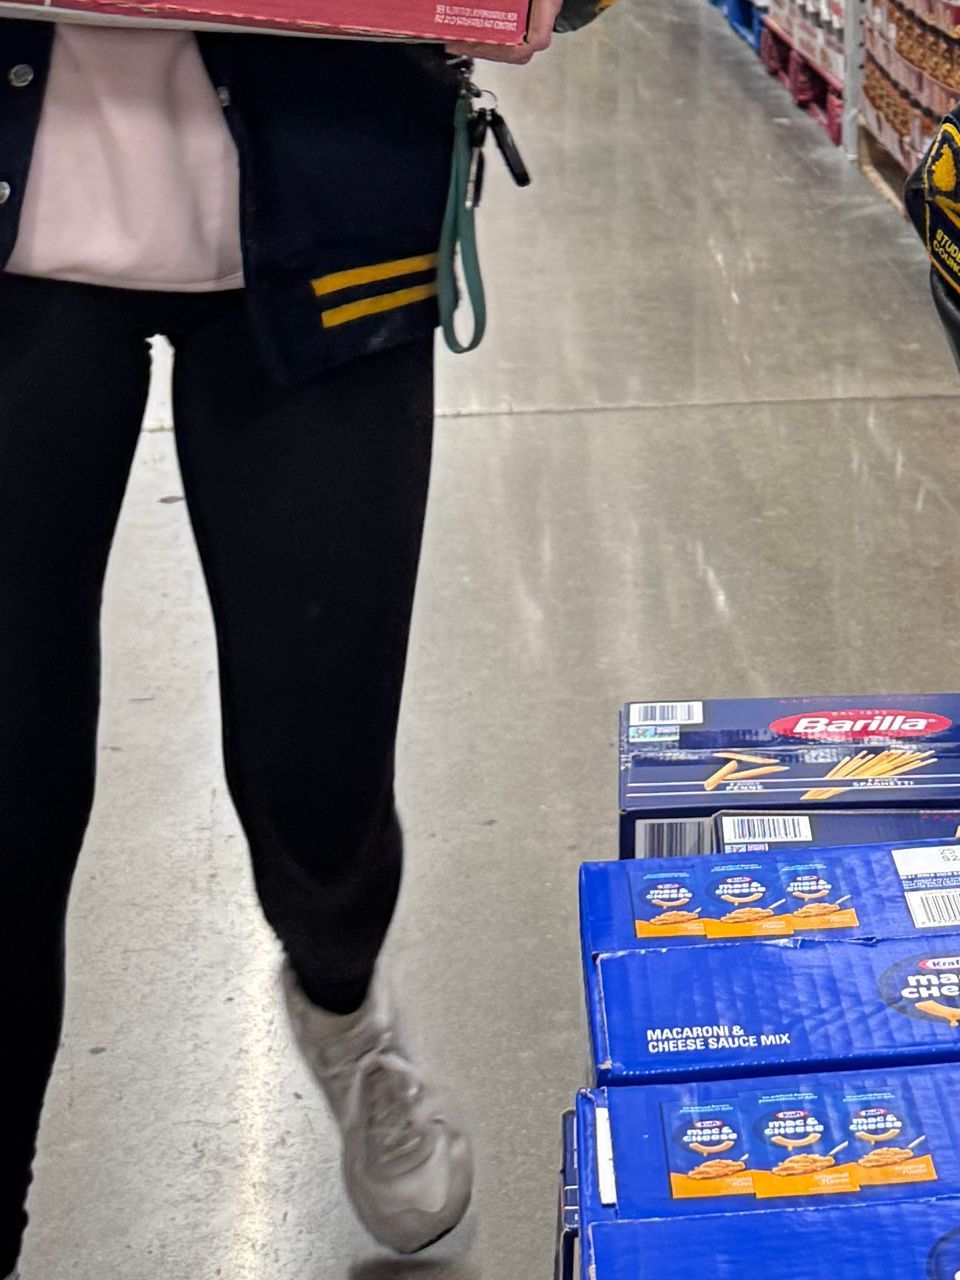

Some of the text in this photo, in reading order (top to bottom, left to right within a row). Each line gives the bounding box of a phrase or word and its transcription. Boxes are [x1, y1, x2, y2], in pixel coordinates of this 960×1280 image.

[792, 714, 931, 736] Barilla
[646, 1023, 745, 1042] MACARONI &
[648, 1032, 791, 1053] CHEESE SAUCE MIX
